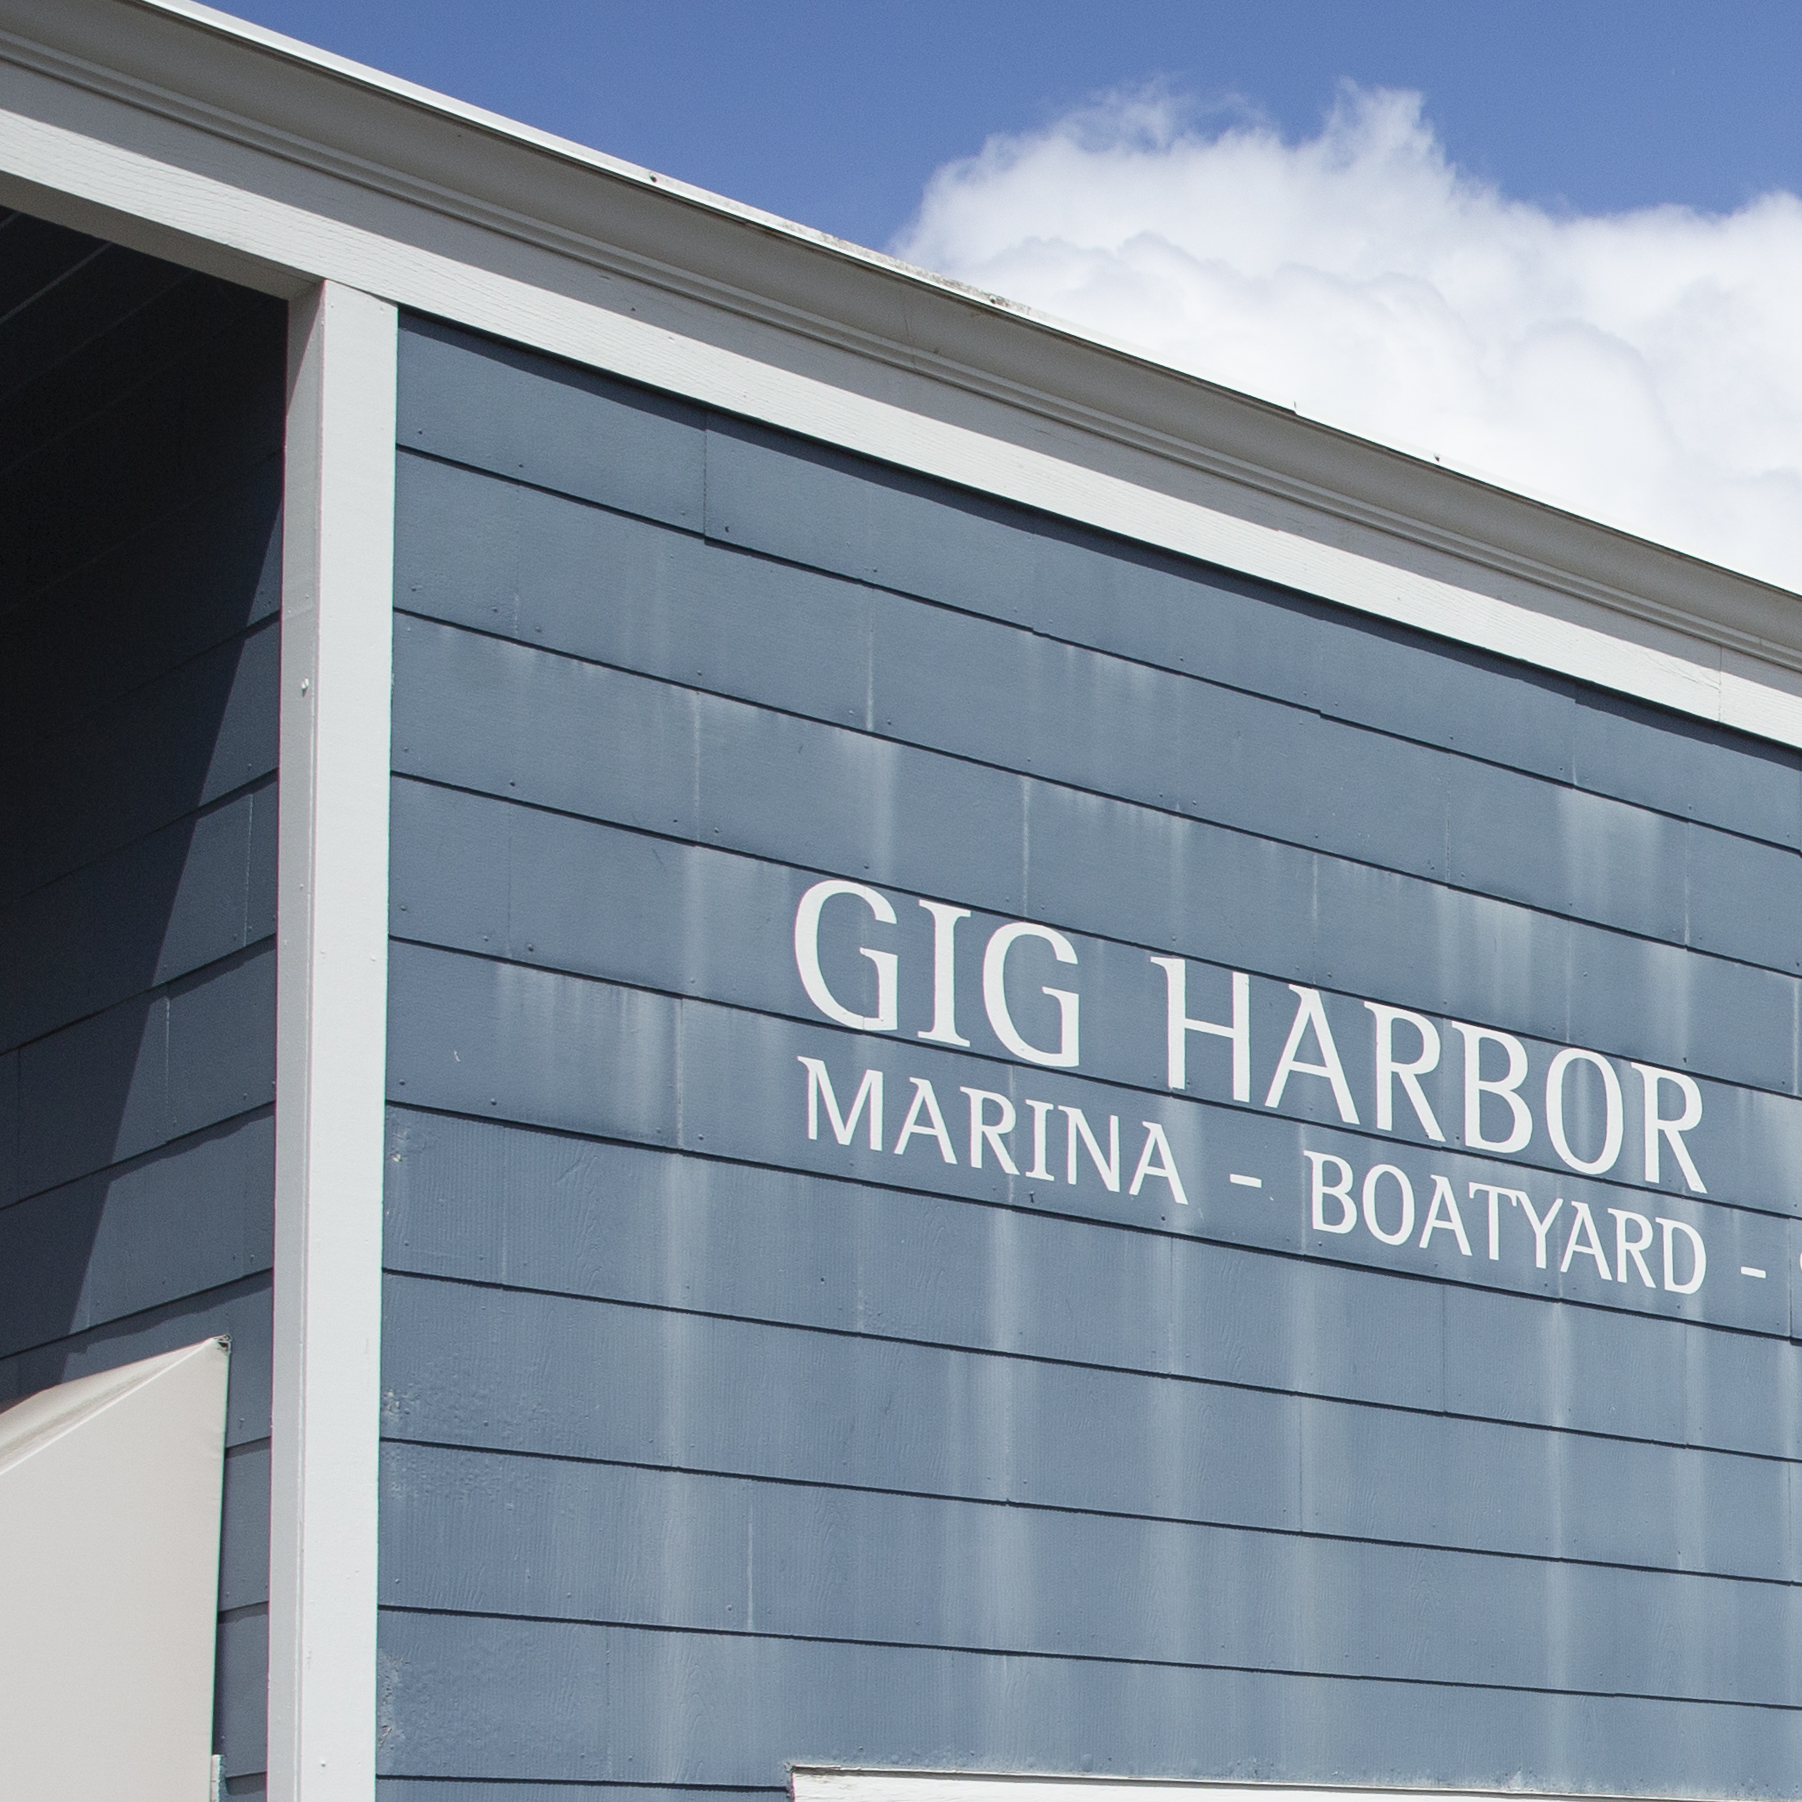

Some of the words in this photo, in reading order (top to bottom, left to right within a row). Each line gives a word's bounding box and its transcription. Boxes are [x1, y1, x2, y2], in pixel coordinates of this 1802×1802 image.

[795, 880, 1079, 1067] GIG
[1151, 957, 1707, 1193] HARBOR
[797, 1056, 1188, 1205] MARINA
[1230, 1174, 1262, 1188] -
[1303, 1150, 1707, 1294] BOATYARD
[1740, 1266, 1766, 1278] -
